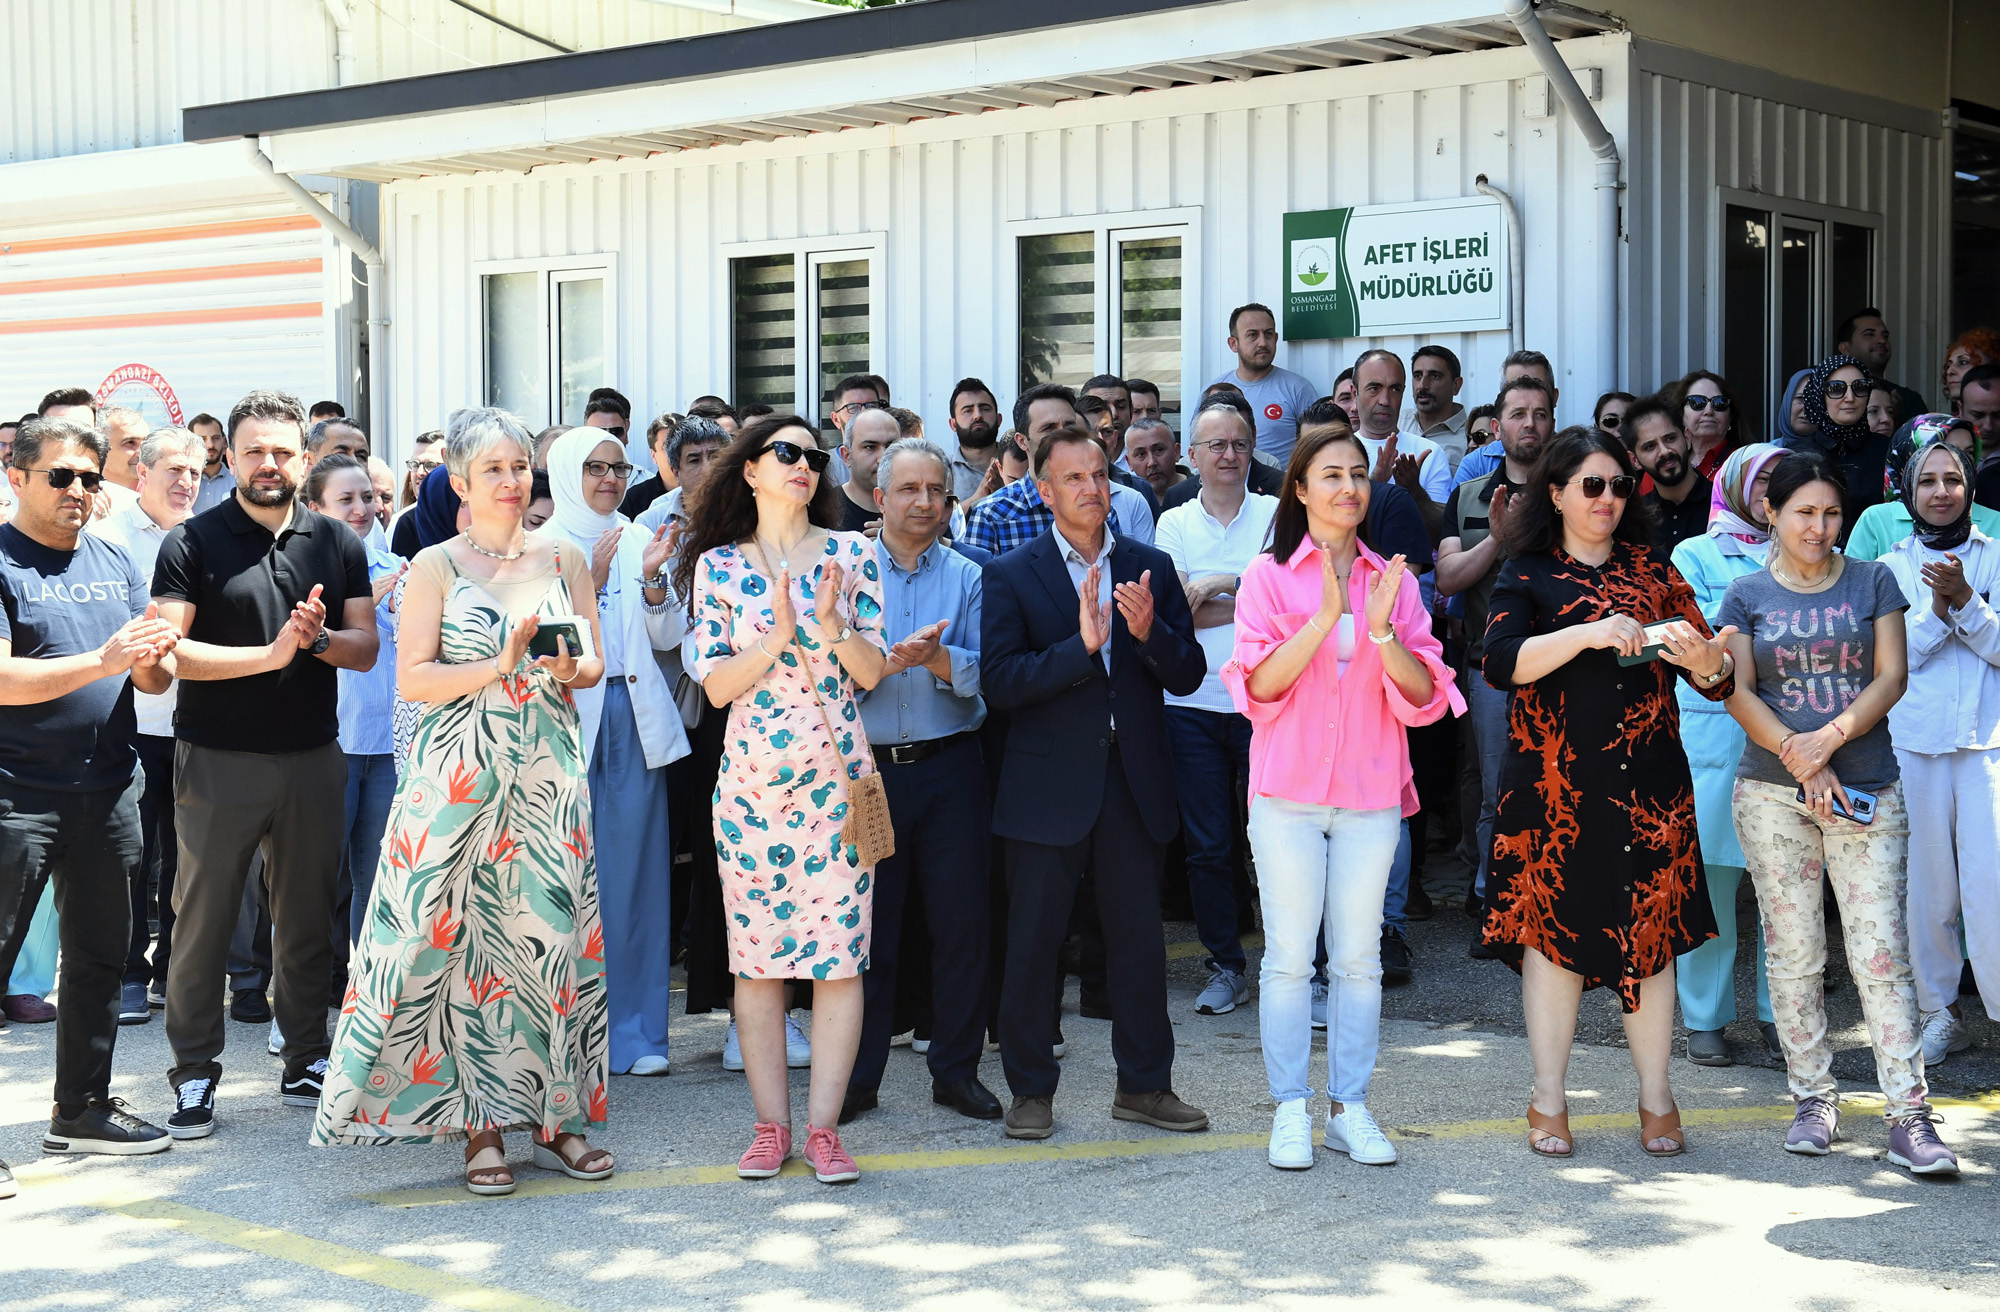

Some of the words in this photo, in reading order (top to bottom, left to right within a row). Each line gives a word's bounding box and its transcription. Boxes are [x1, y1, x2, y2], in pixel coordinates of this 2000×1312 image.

[1364, 242, 1416, 265] AFET
[1423, 231, 1489, 264] İŞLERİ
[1290, 293, 1337, 304] OSMANGAZİ
[1360, 267, 1493, 300] MÜDÜRLÜĞÜ
[1291, 303, 1337, 313] BELEDİYESİ
[23, 581, 130, 603] LACOSTE
[1763, 602, 1859, 641] SUM
[1774, 639, 1864, 677] MER
[1779, 676, 1861, 713] SUN
